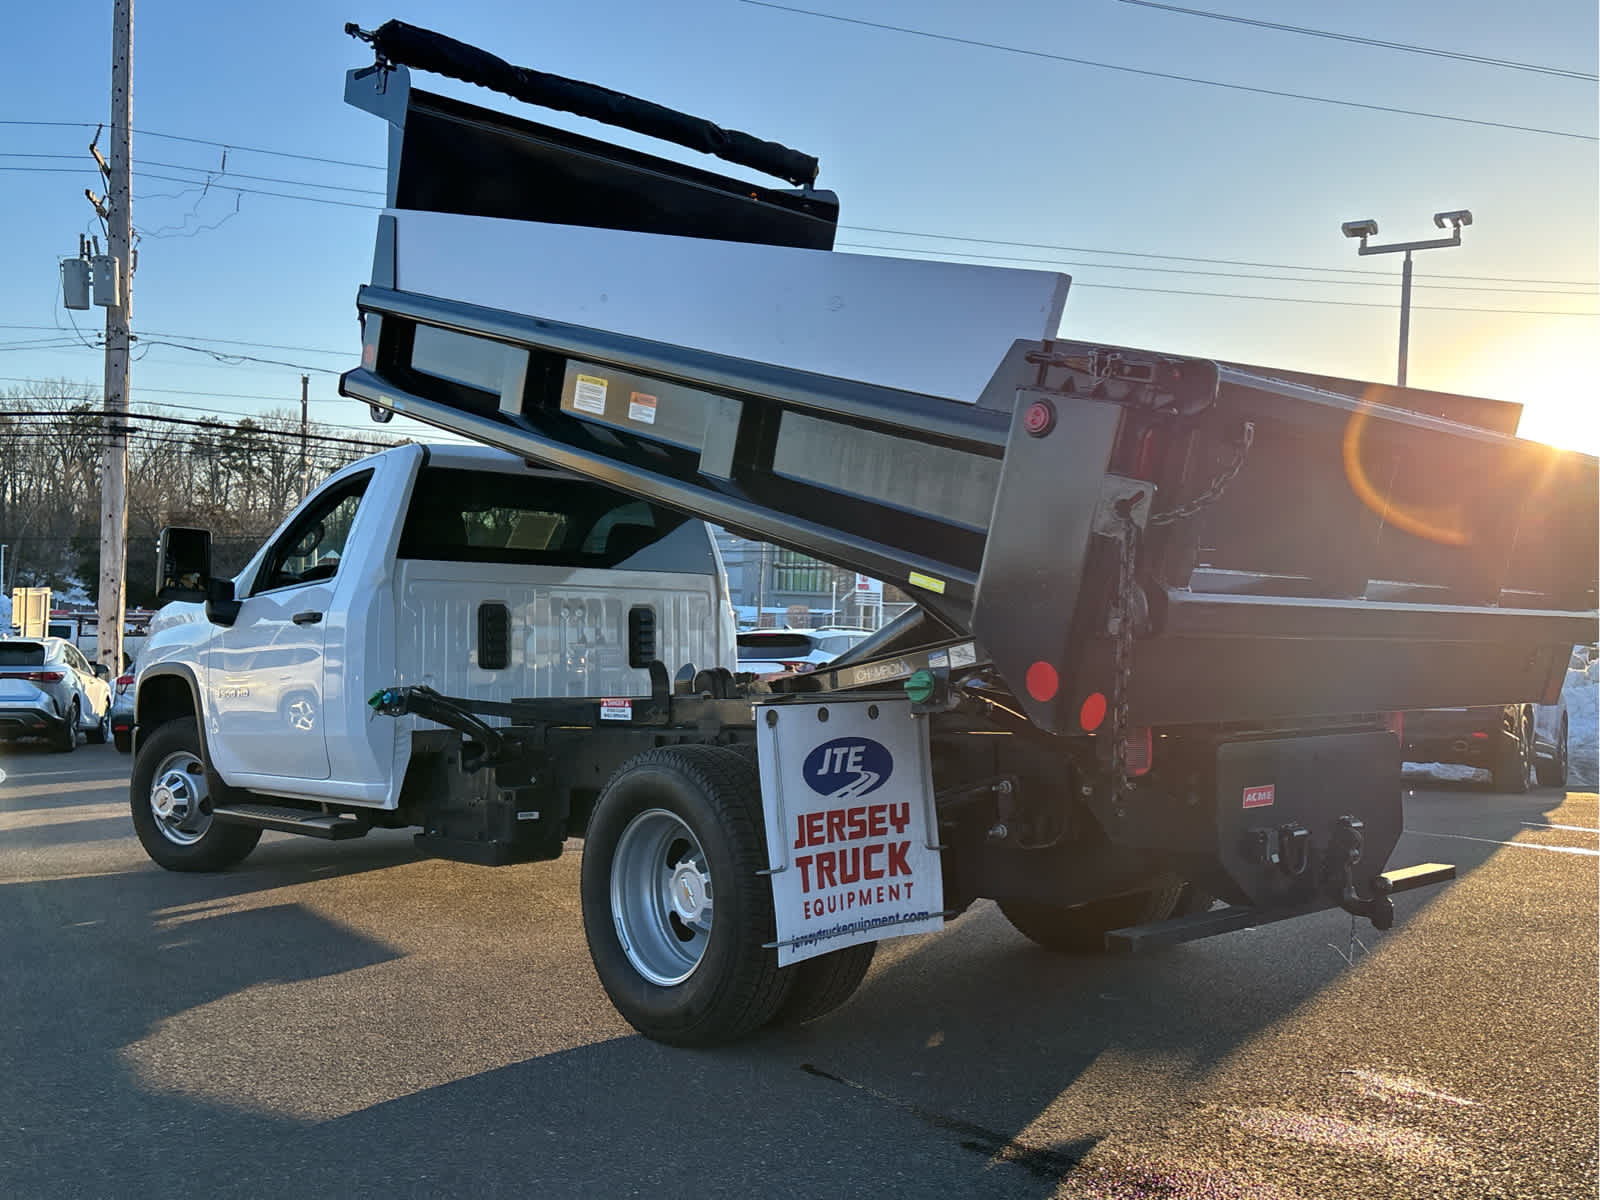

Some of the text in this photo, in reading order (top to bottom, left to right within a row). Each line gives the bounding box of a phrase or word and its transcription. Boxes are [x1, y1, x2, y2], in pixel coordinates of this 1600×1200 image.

[816, 745, 866, 776] JTE
[1246, 791, 1273, 802] ACME
[794, 802, 910, 849] JERSEY
[795, 840, 913, 893] TRUCK
[803, 882, 914, 920] EQUIPMENT
[791, 911, 929, 953] jerseytruckequipment.com
